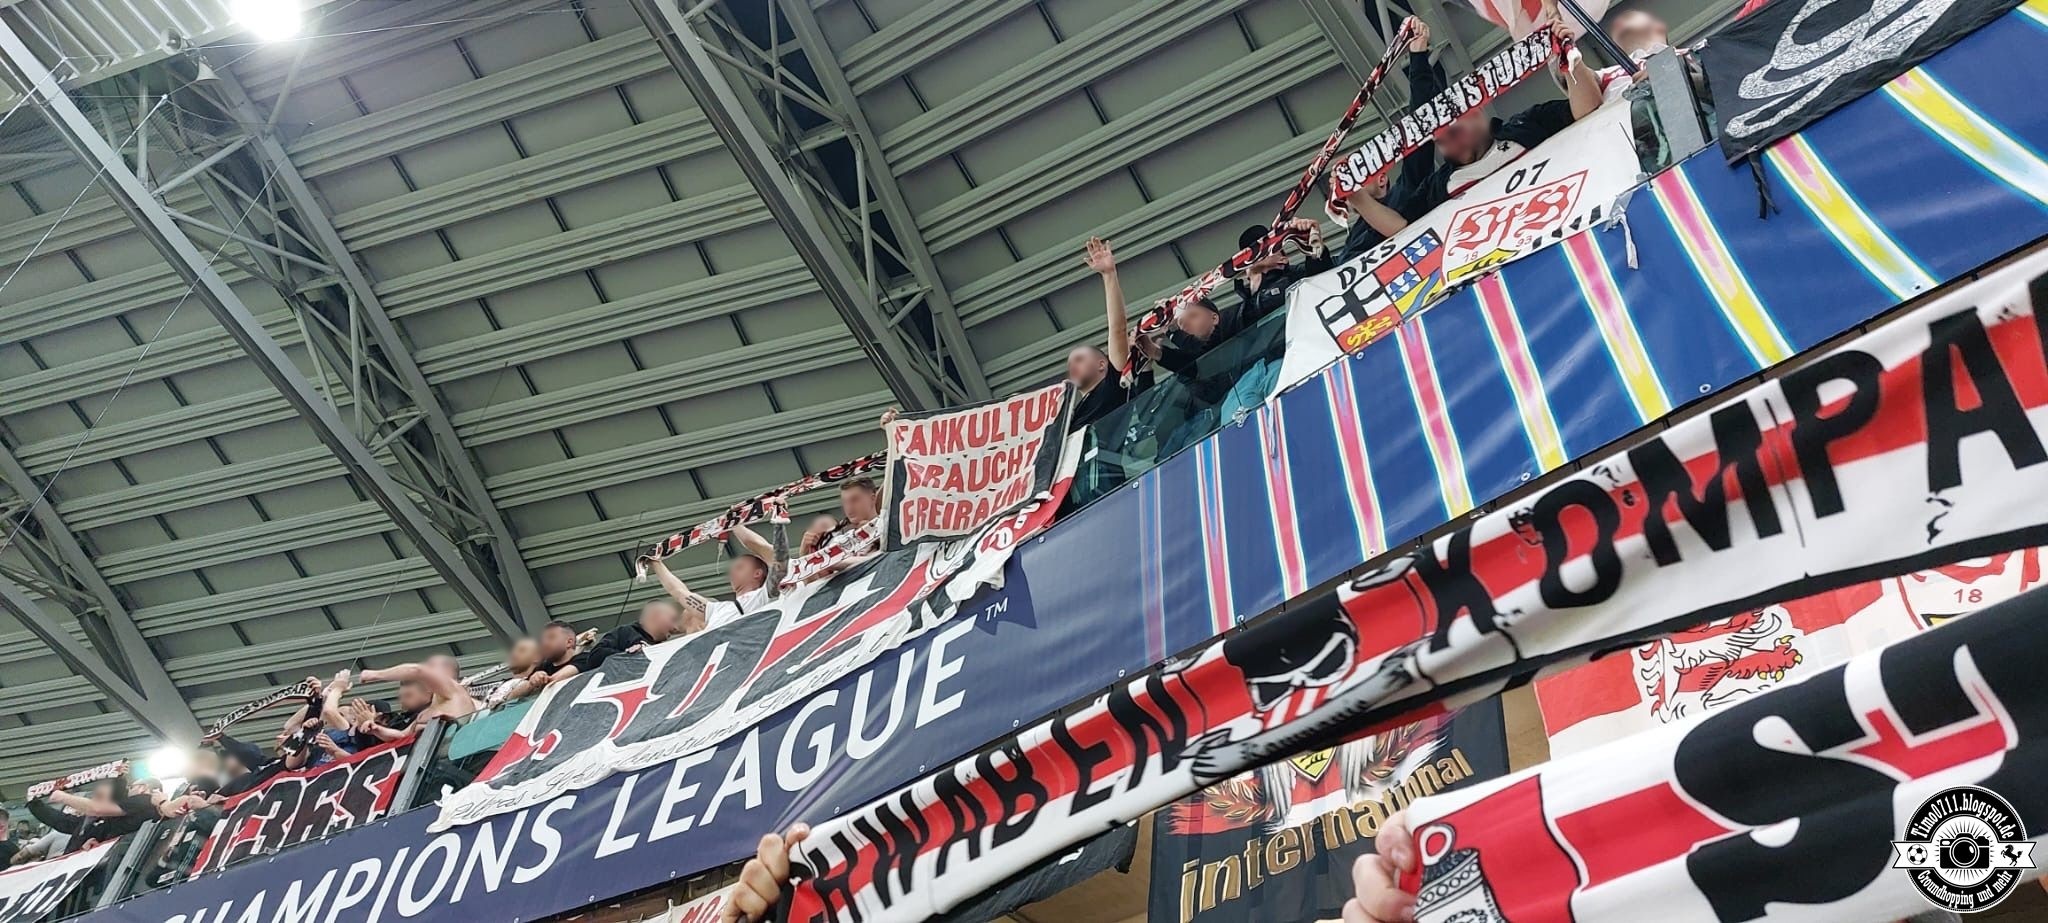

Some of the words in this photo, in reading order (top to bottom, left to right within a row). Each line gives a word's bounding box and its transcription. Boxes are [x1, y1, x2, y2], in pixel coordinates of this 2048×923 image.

[1336, 28, 1551, 191] SCHWABENSTURM
[1337, 239, 1396, 289] DKS
[1505, 158, 1550, 193] 07
[895, 387, 1063, 456] FANKULTUR
[907, 437, 1041, 492] BRAUCHT
[1422, 272, 2048, 656] KOMPA
[902, 472, 1032, 538] FREIRAUM
[985, 596, 1009, 619] TM
[1953, 588, 1983, 604] 18
[594, 614, 978, 860] LEAGUE
[1179, 748, 1476, 923] international
